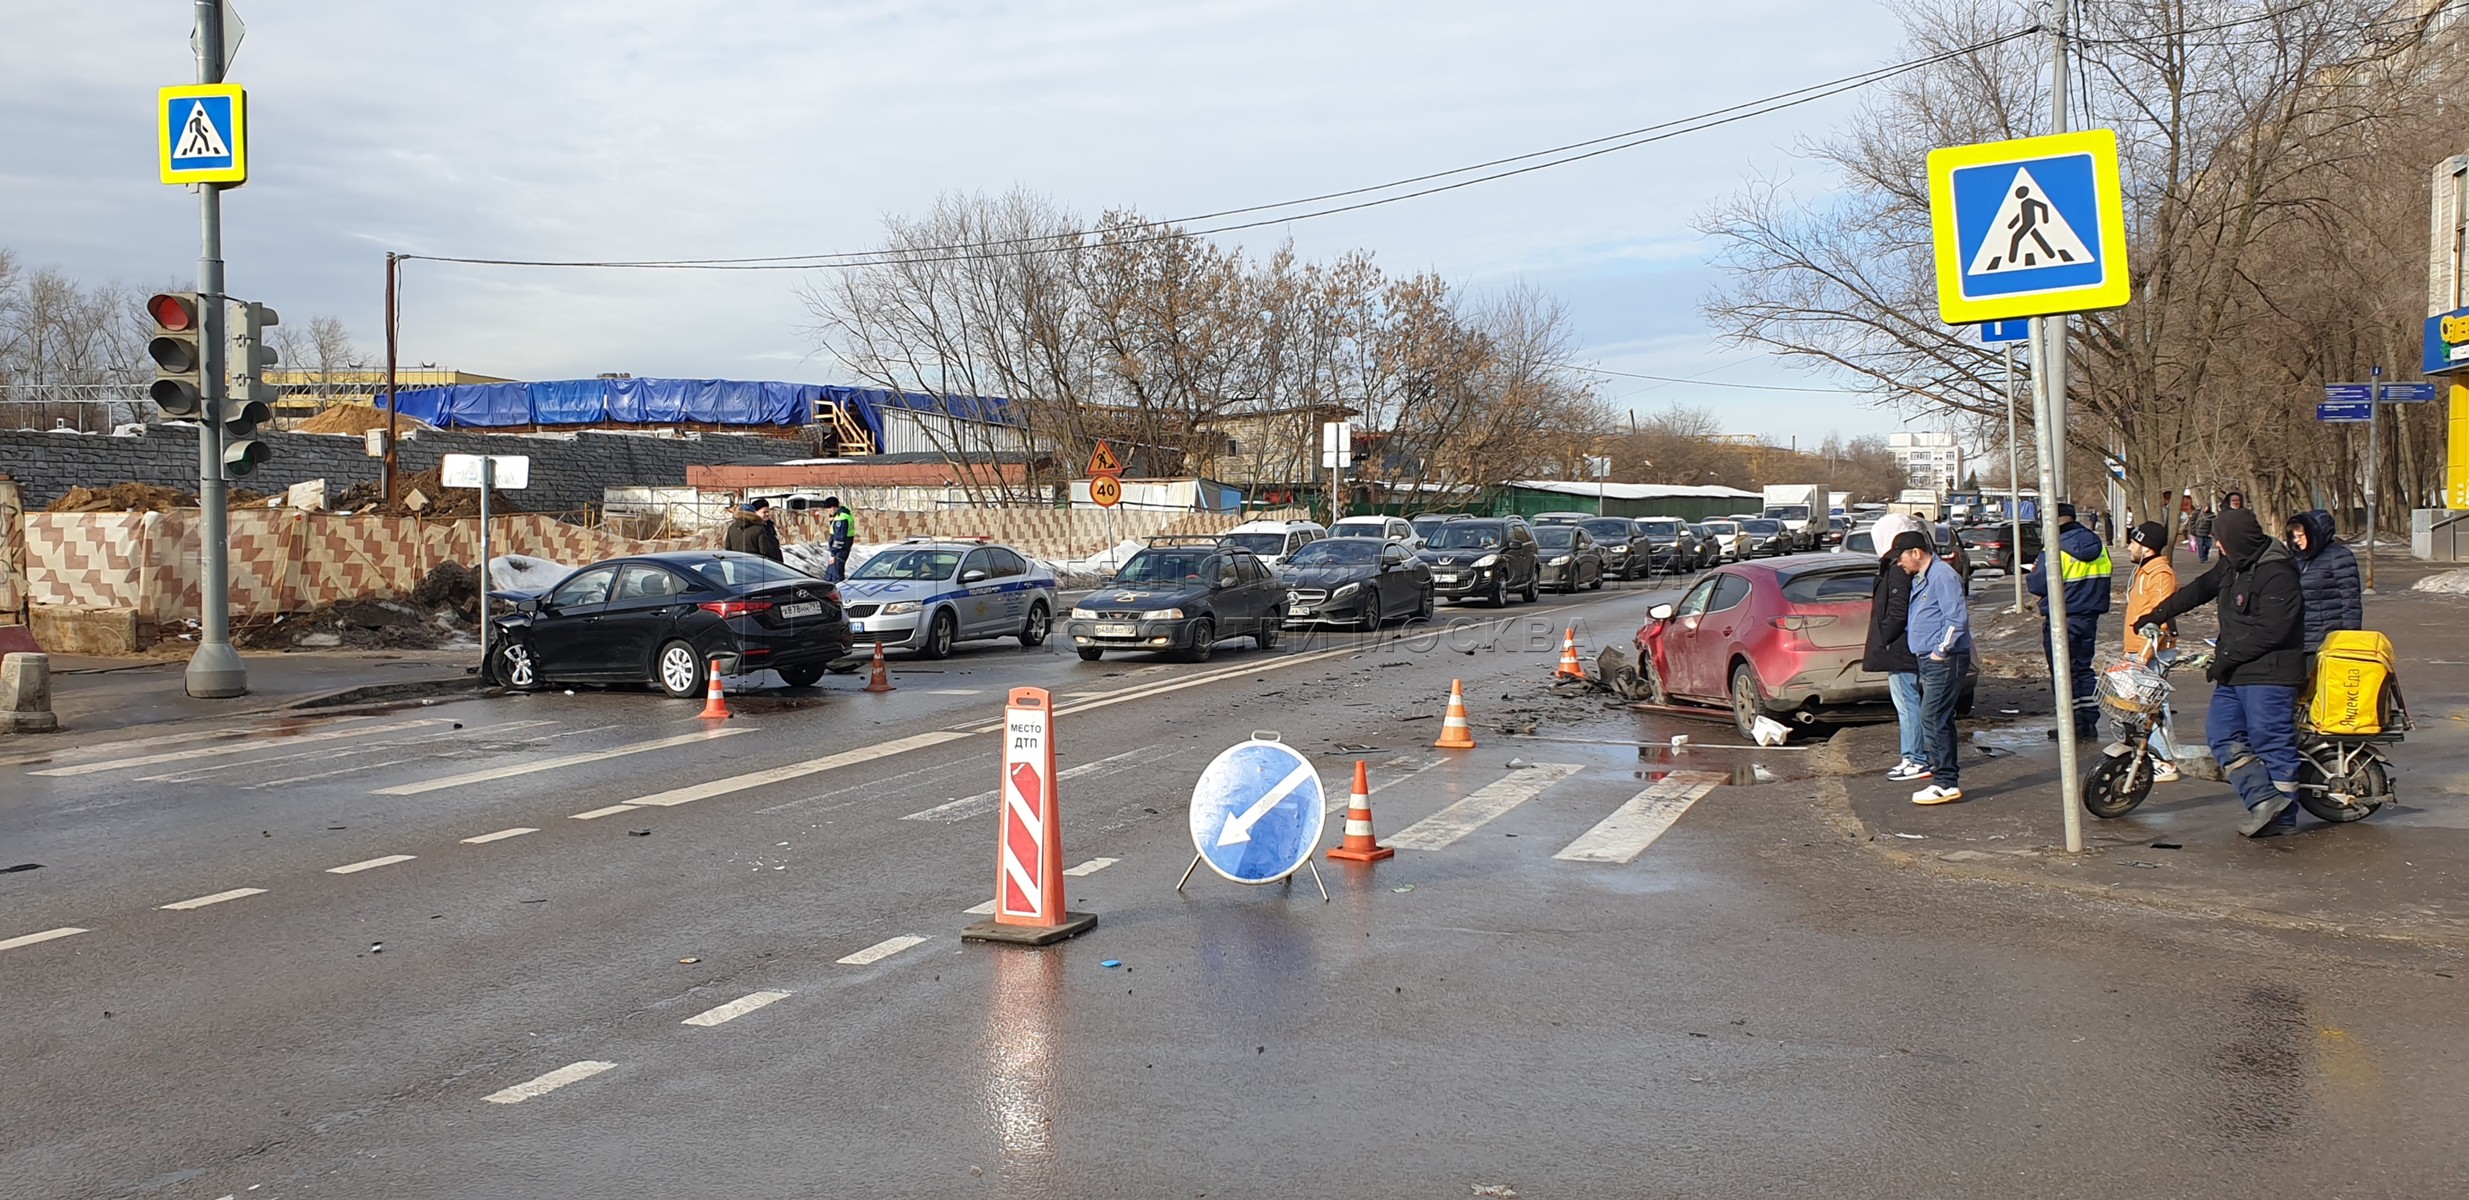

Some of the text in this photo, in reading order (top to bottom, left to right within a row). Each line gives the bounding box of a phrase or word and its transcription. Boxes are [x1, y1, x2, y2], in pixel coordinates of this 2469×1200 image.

[1097, 484, 1115, 497] 40
[2339, 668, 2361, 729] Яндекс Еда
[1010, 723, 1042, 734] МЕСТО
[1014, 737, 1037, 750] ДТП
